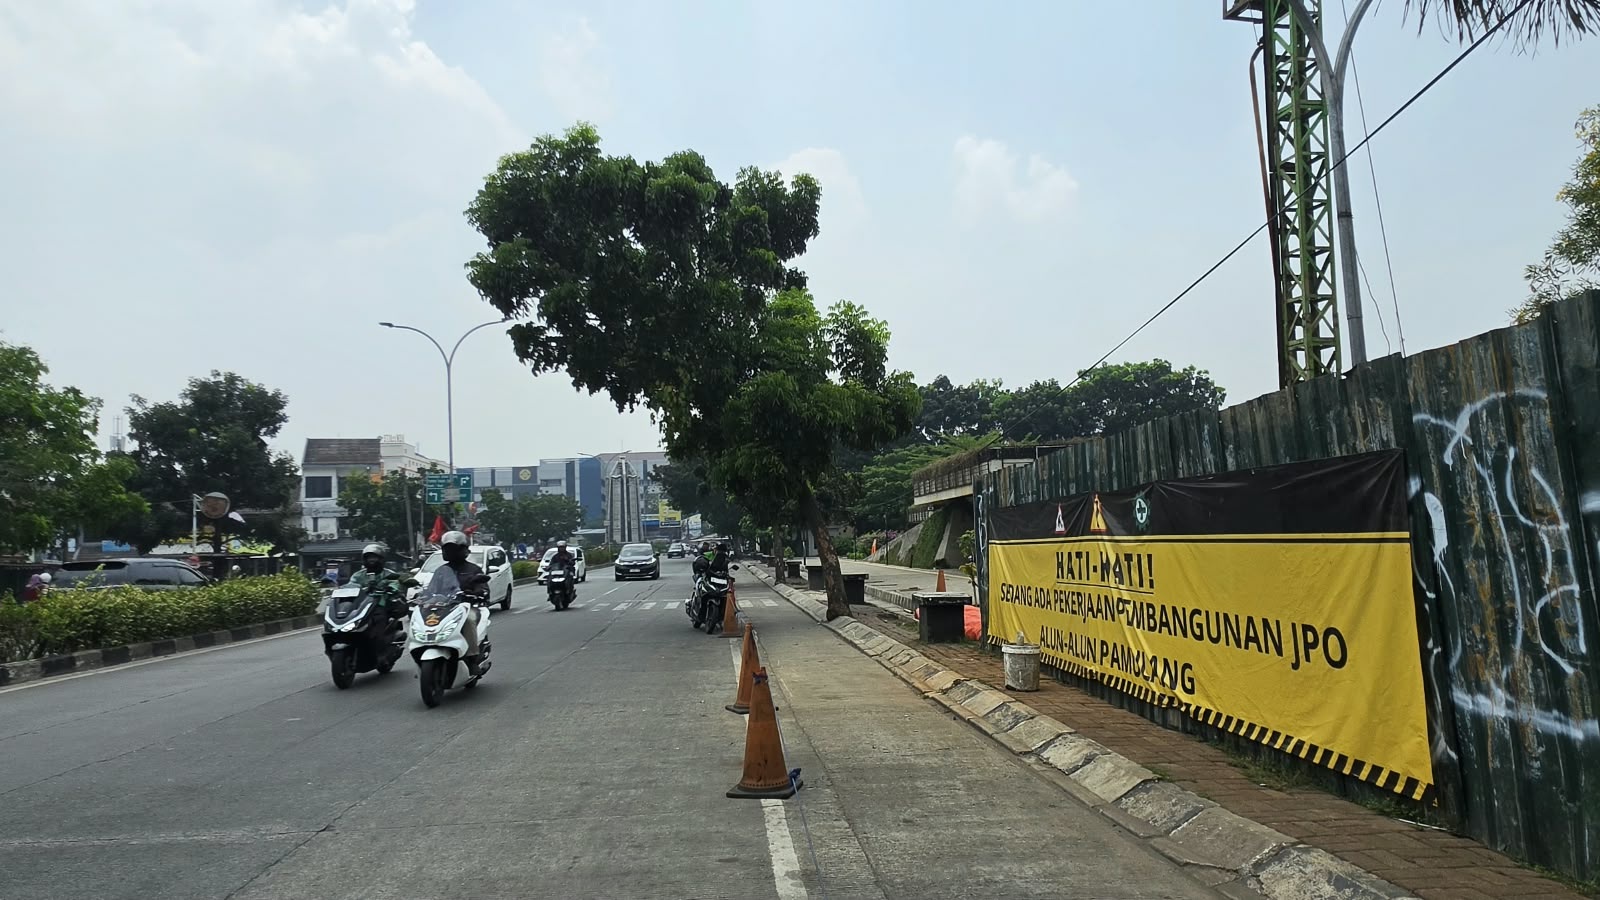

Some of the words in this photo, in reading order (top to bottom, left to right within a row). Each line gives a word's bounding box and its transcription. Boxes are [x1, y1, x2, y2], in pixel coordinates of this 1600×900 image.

[1056, 551, 1155, 589] HATI-HATI!
[1034, 587, 1052, 610] ADA
[1053, 588, 1115, 624] PEKERJAAN
[1290, 622, 1348, 671] JPO
[1039, 625, 1097, 663] ALUN-ALUN
